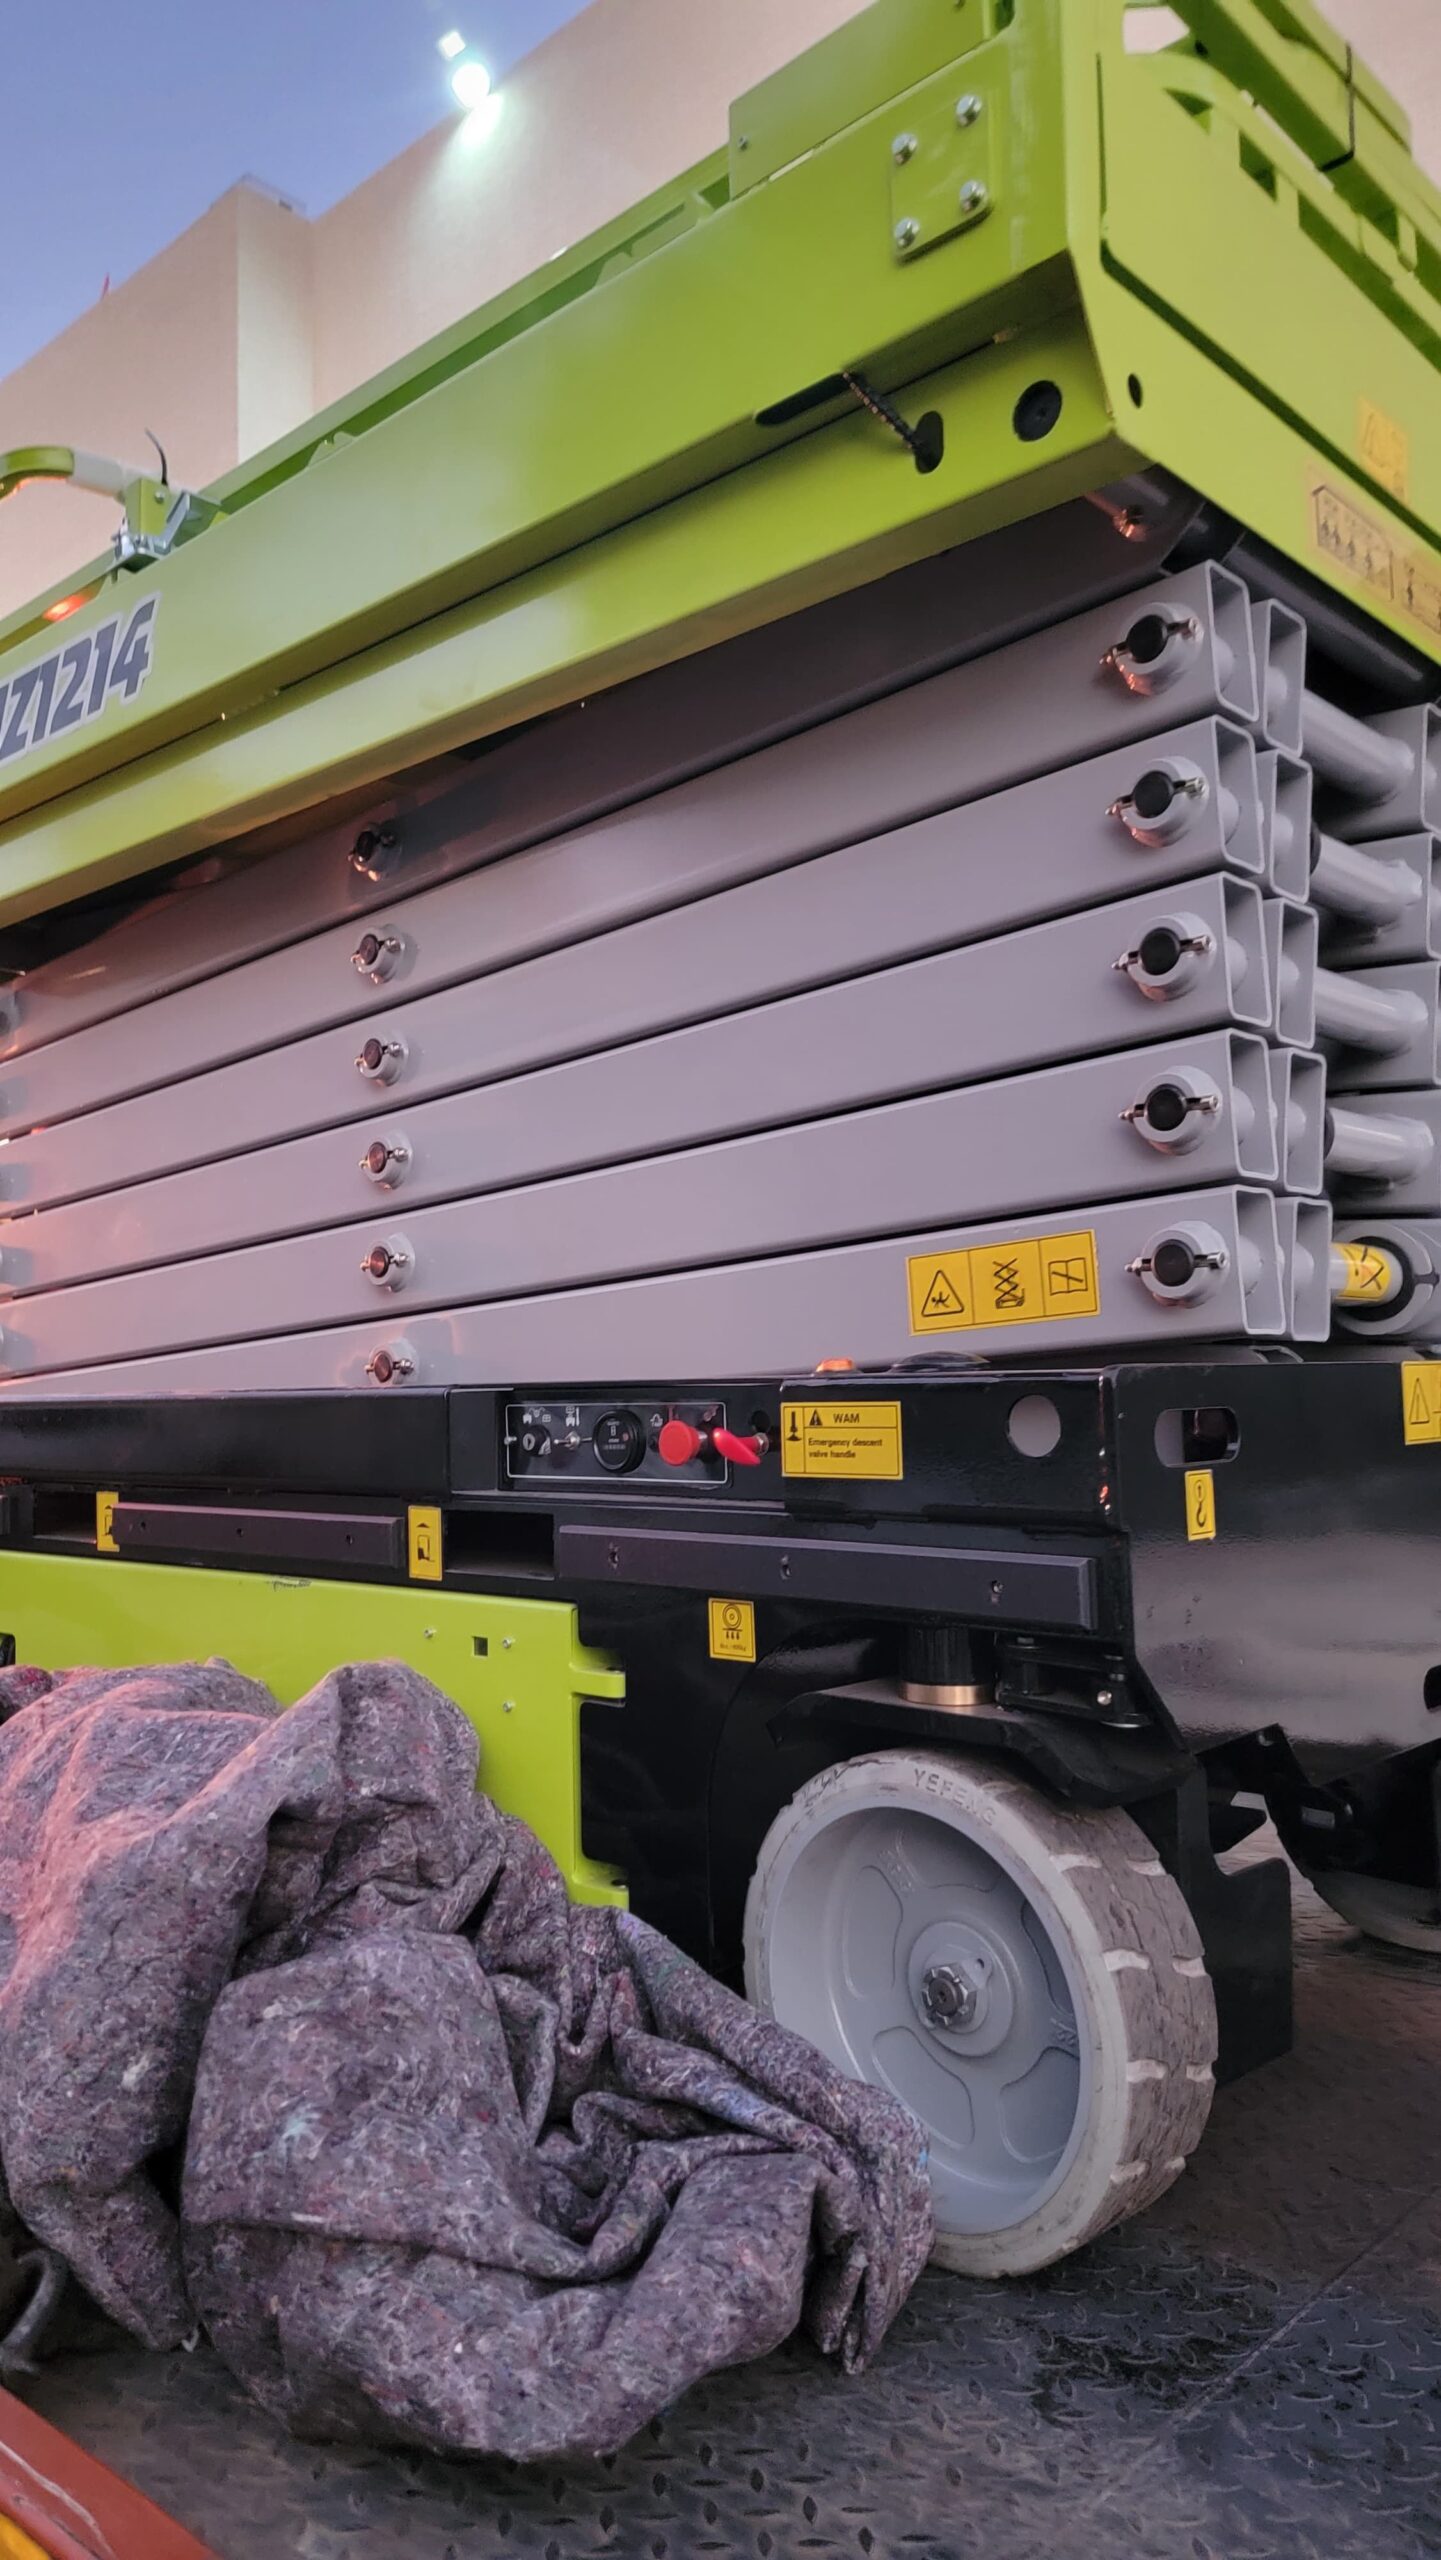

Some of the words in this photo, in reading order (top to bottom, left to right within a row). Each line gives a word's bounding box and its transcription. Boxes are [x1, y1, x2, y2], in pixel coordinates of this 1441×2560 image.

[0, 598, 156, 761] Z1214
[808, 1437, 850, 1448] Emergency
[852, 1437, 883, 1447] descent
[809, 1450, 829, 1458] valve
[830, 1450, 856, 1458] handle
